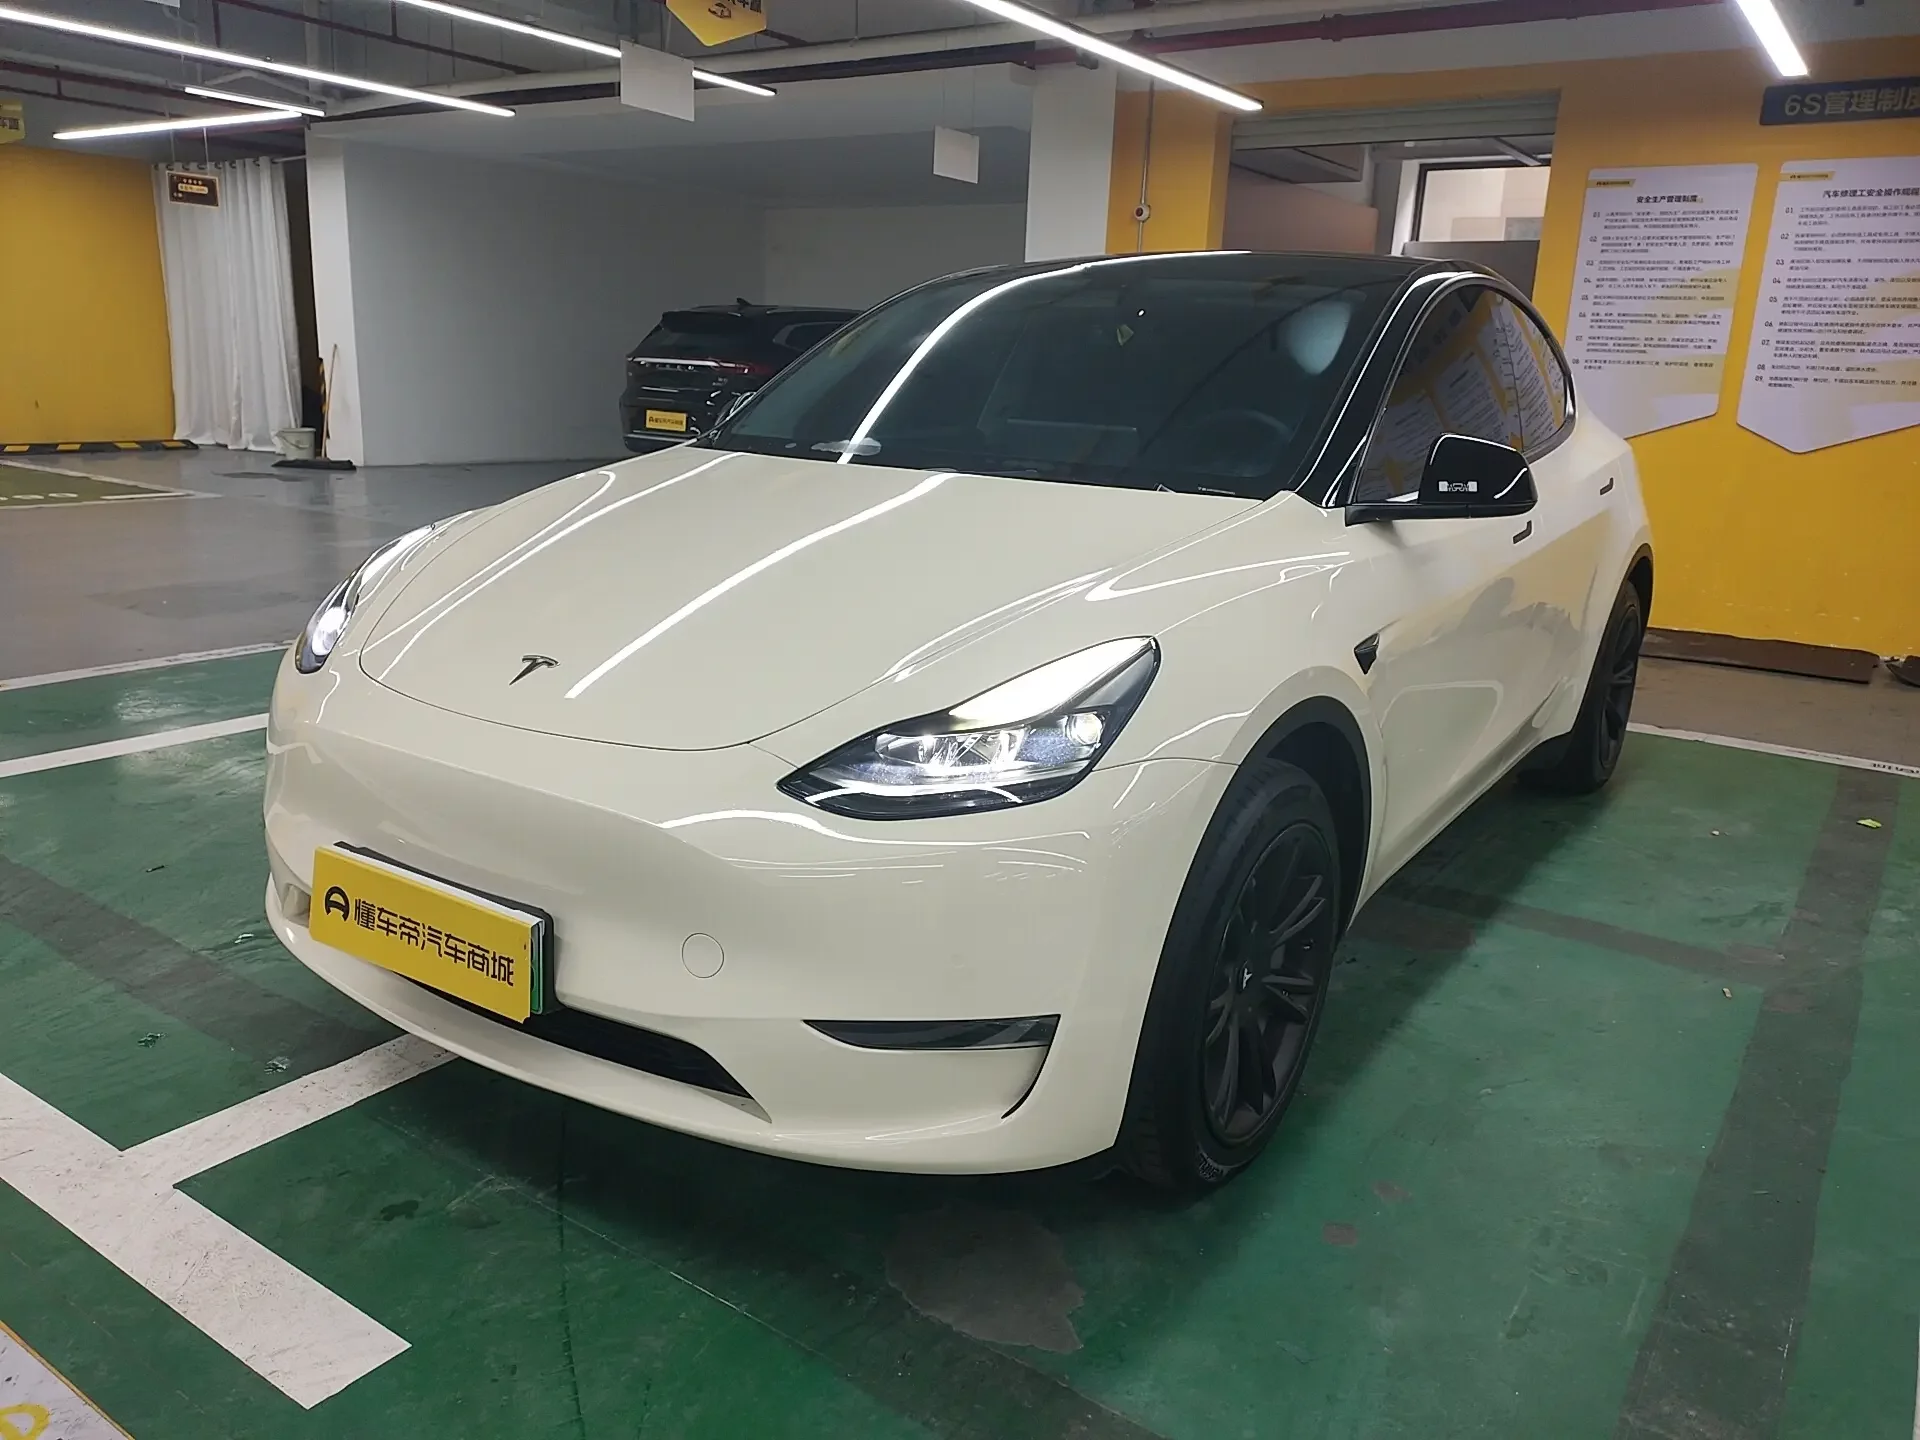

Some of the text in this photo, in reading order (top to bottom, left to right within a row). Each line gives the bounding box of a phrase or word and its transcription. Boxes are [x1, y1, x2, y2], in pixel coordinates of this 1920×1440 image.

[1784, 87, 1920, 116] 6S管理制度
[354, 898, 514, 987] 懂车帝汽车商城
